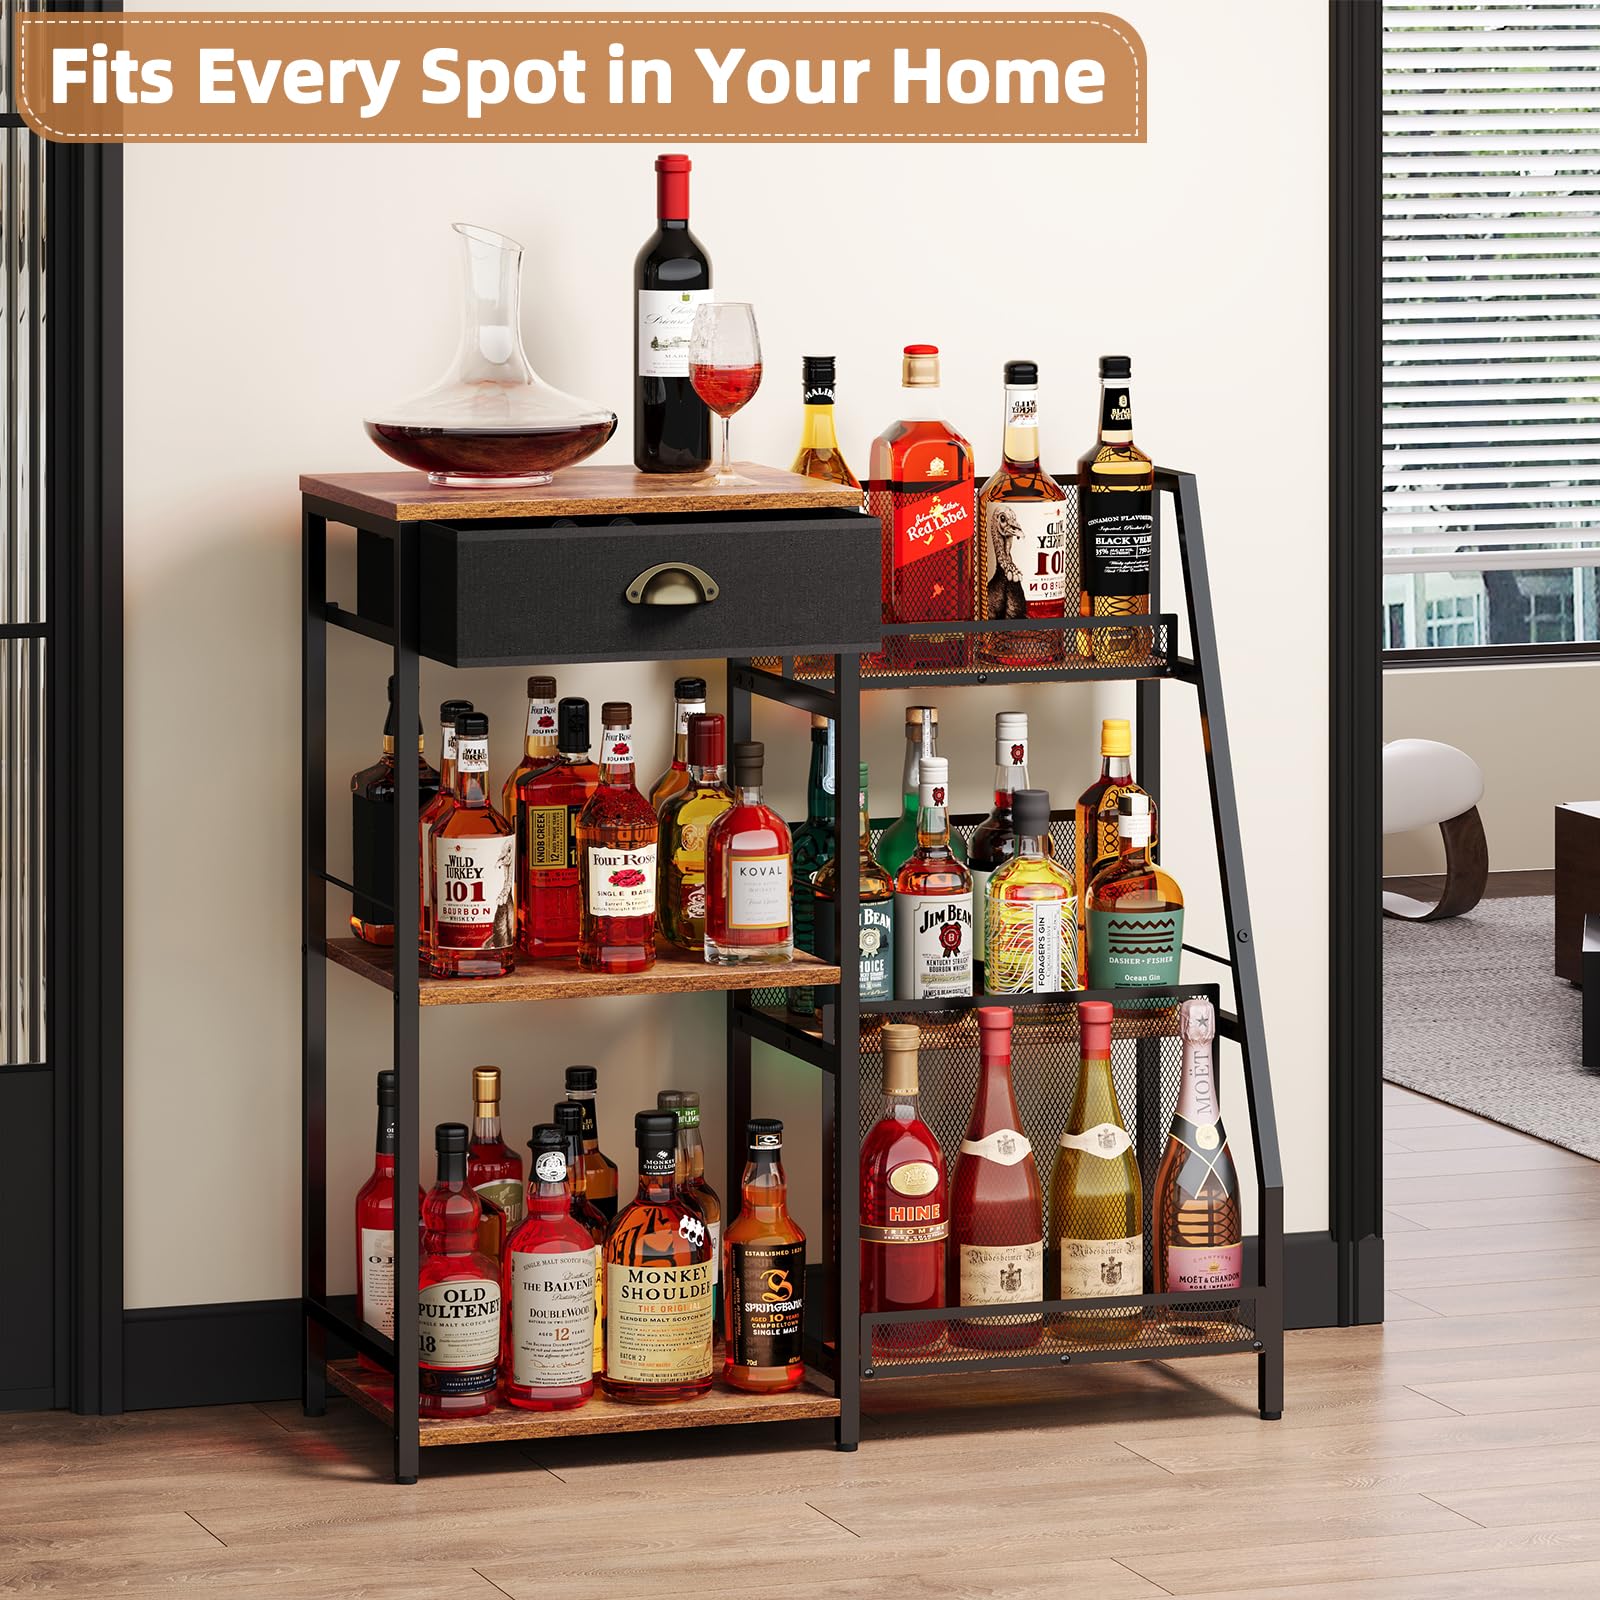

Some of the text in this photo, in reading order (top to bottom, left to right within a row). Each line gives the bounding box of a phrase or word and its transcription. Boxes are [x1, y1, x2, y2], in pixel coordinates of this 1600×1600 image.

[906, 506, 969, 542] Red Label
[1095, 537, 1131, 545] BLACK
[536, 812, 545, 863] KNOB CREEK
[448, 854, 474, 868] WILD
[550, 853, 560, 862] 12
[593, 853, 621, 866] Four
[444, 864, 484, 880] TURKEY
[740, 866, 783, 877] KOVAL
[445, 881, 486, 903] 101
[442, 906, 491, 915] BOURBON
[919, 909, 946, 934] JIM
[948, 933, 955, 942] B
[1038, 917, 1046, 986] FORAGER'S GIN
[1109, 957, 1141, 965] DASHER
[1124, 974, 1148, 982] Ocean
[1189, 1050, 1212, 1115] MOËT
[889, 1203, 941, 1222] HINE
[883, 1224, 945, 1235] TRIOMPHE
[744, 1249, 790, 1257] ESTABLISHED
[541, 1258, 558, 1266] MALT
[628, 1265, 708, 1284] MONKEY
[1179, 1273, 1204, 1284] MOËT
[1209, 1271, 1240, 1284] CHANDON
[522, 1281, 541, 1292] THE
[759, 1268, 793, 1303] S
[443, 1287, 486, 1303] OLD
[638, 1304, 656, 1313] THE
[744, 1298, 803, 1313] SPRINGBANK
[672, 1315, 699, 1323] SCOTCH
[769, 1313, 785, 1323] 10
[751, 1320, 799, 1329] CAMPBELTOWN
[752, 1325, 798, 1336] SINGLE MALT
[554, 1327, 570, 1341] 12
[418, 1334, 437, 1353] 18
[619, 1352, 637, 1361] BATCH
